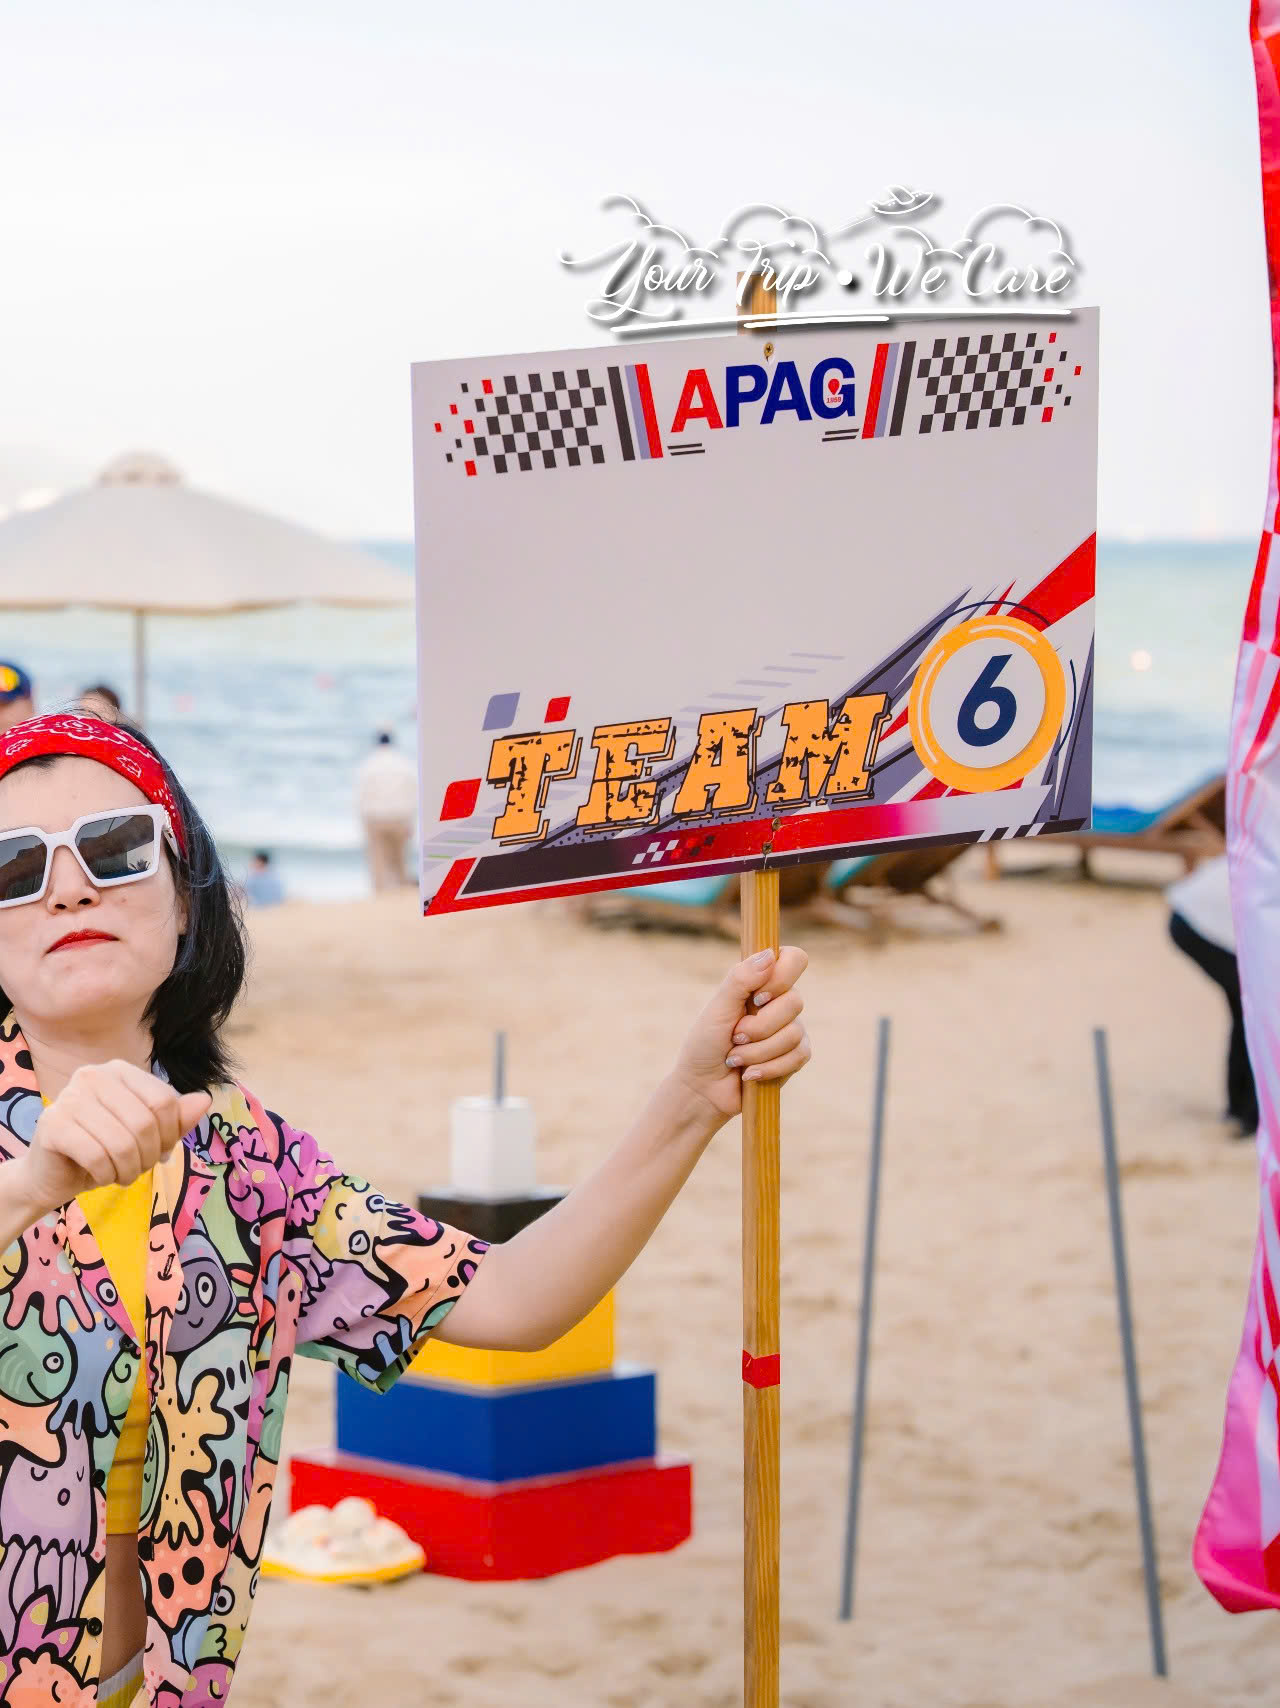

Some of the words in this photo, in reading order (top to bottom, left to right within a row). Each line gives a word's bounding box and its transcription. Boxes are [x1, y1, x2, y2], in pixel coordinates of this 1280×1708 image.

[670, 356, 856, 433] APAG
[486, 691, 893, 847] TEAM
[956, 654, 1018, 748] 6
